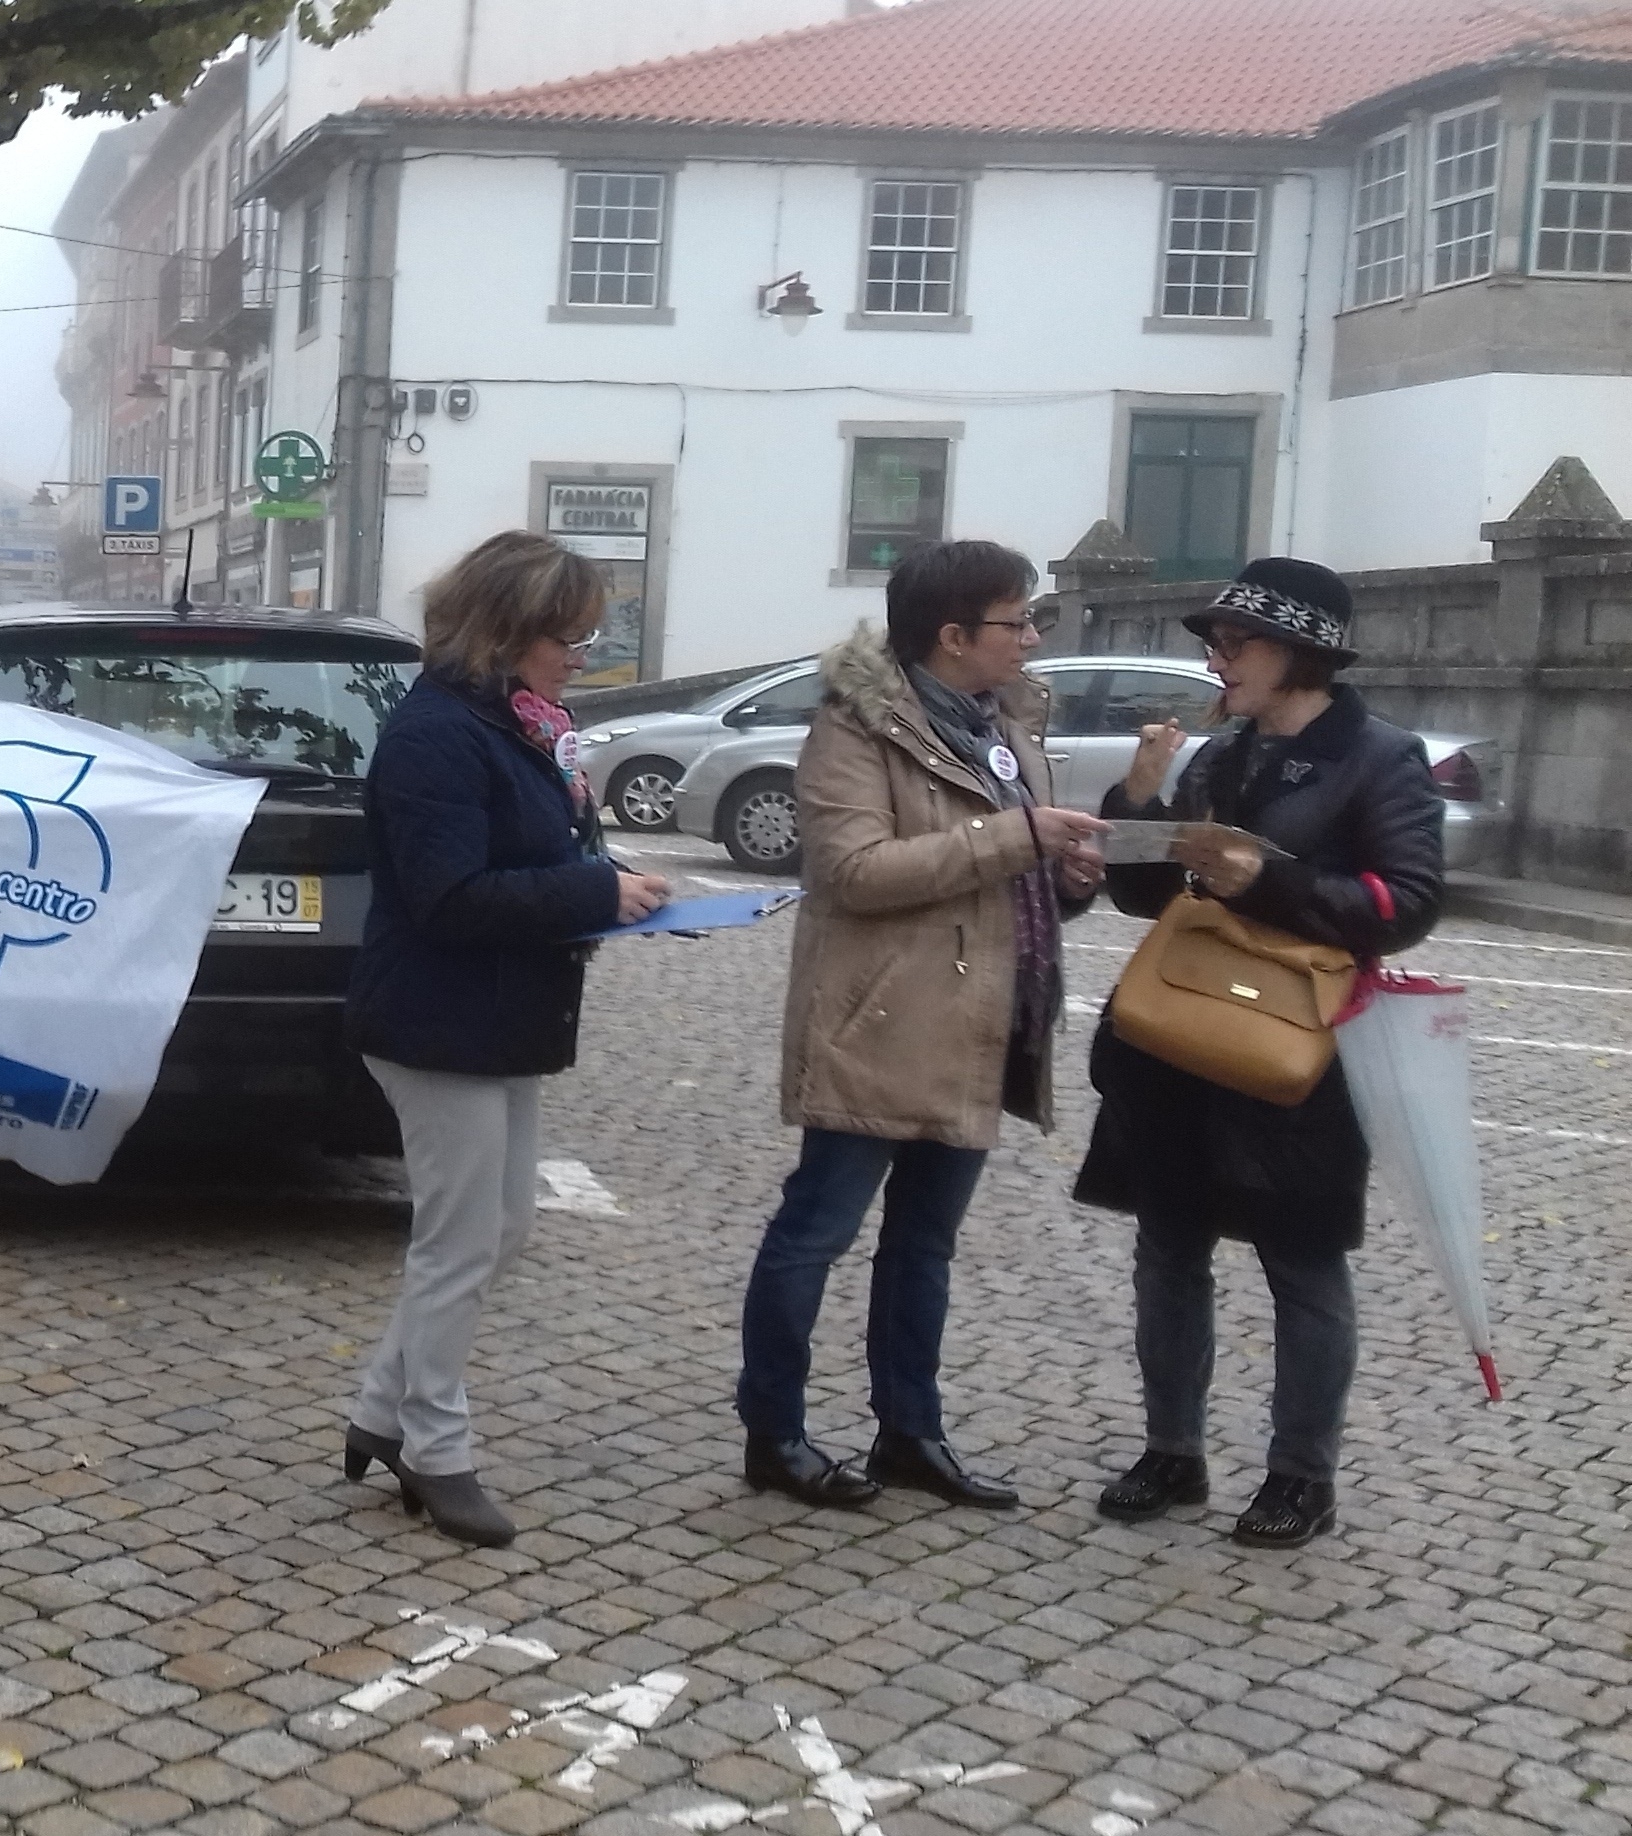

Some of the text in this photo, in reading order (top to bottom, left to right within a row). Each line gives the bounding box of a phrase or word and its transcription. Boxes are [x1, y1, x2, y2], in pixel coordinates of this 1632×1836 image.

[115, 485, 149, 525] P
[553, 488, 646, 508] FARMÁCIA
[562, 510, 638, 528] CENTRAL
[120, 540, 154, 550] TAXIS
[303, 904, 318, 917] 07
